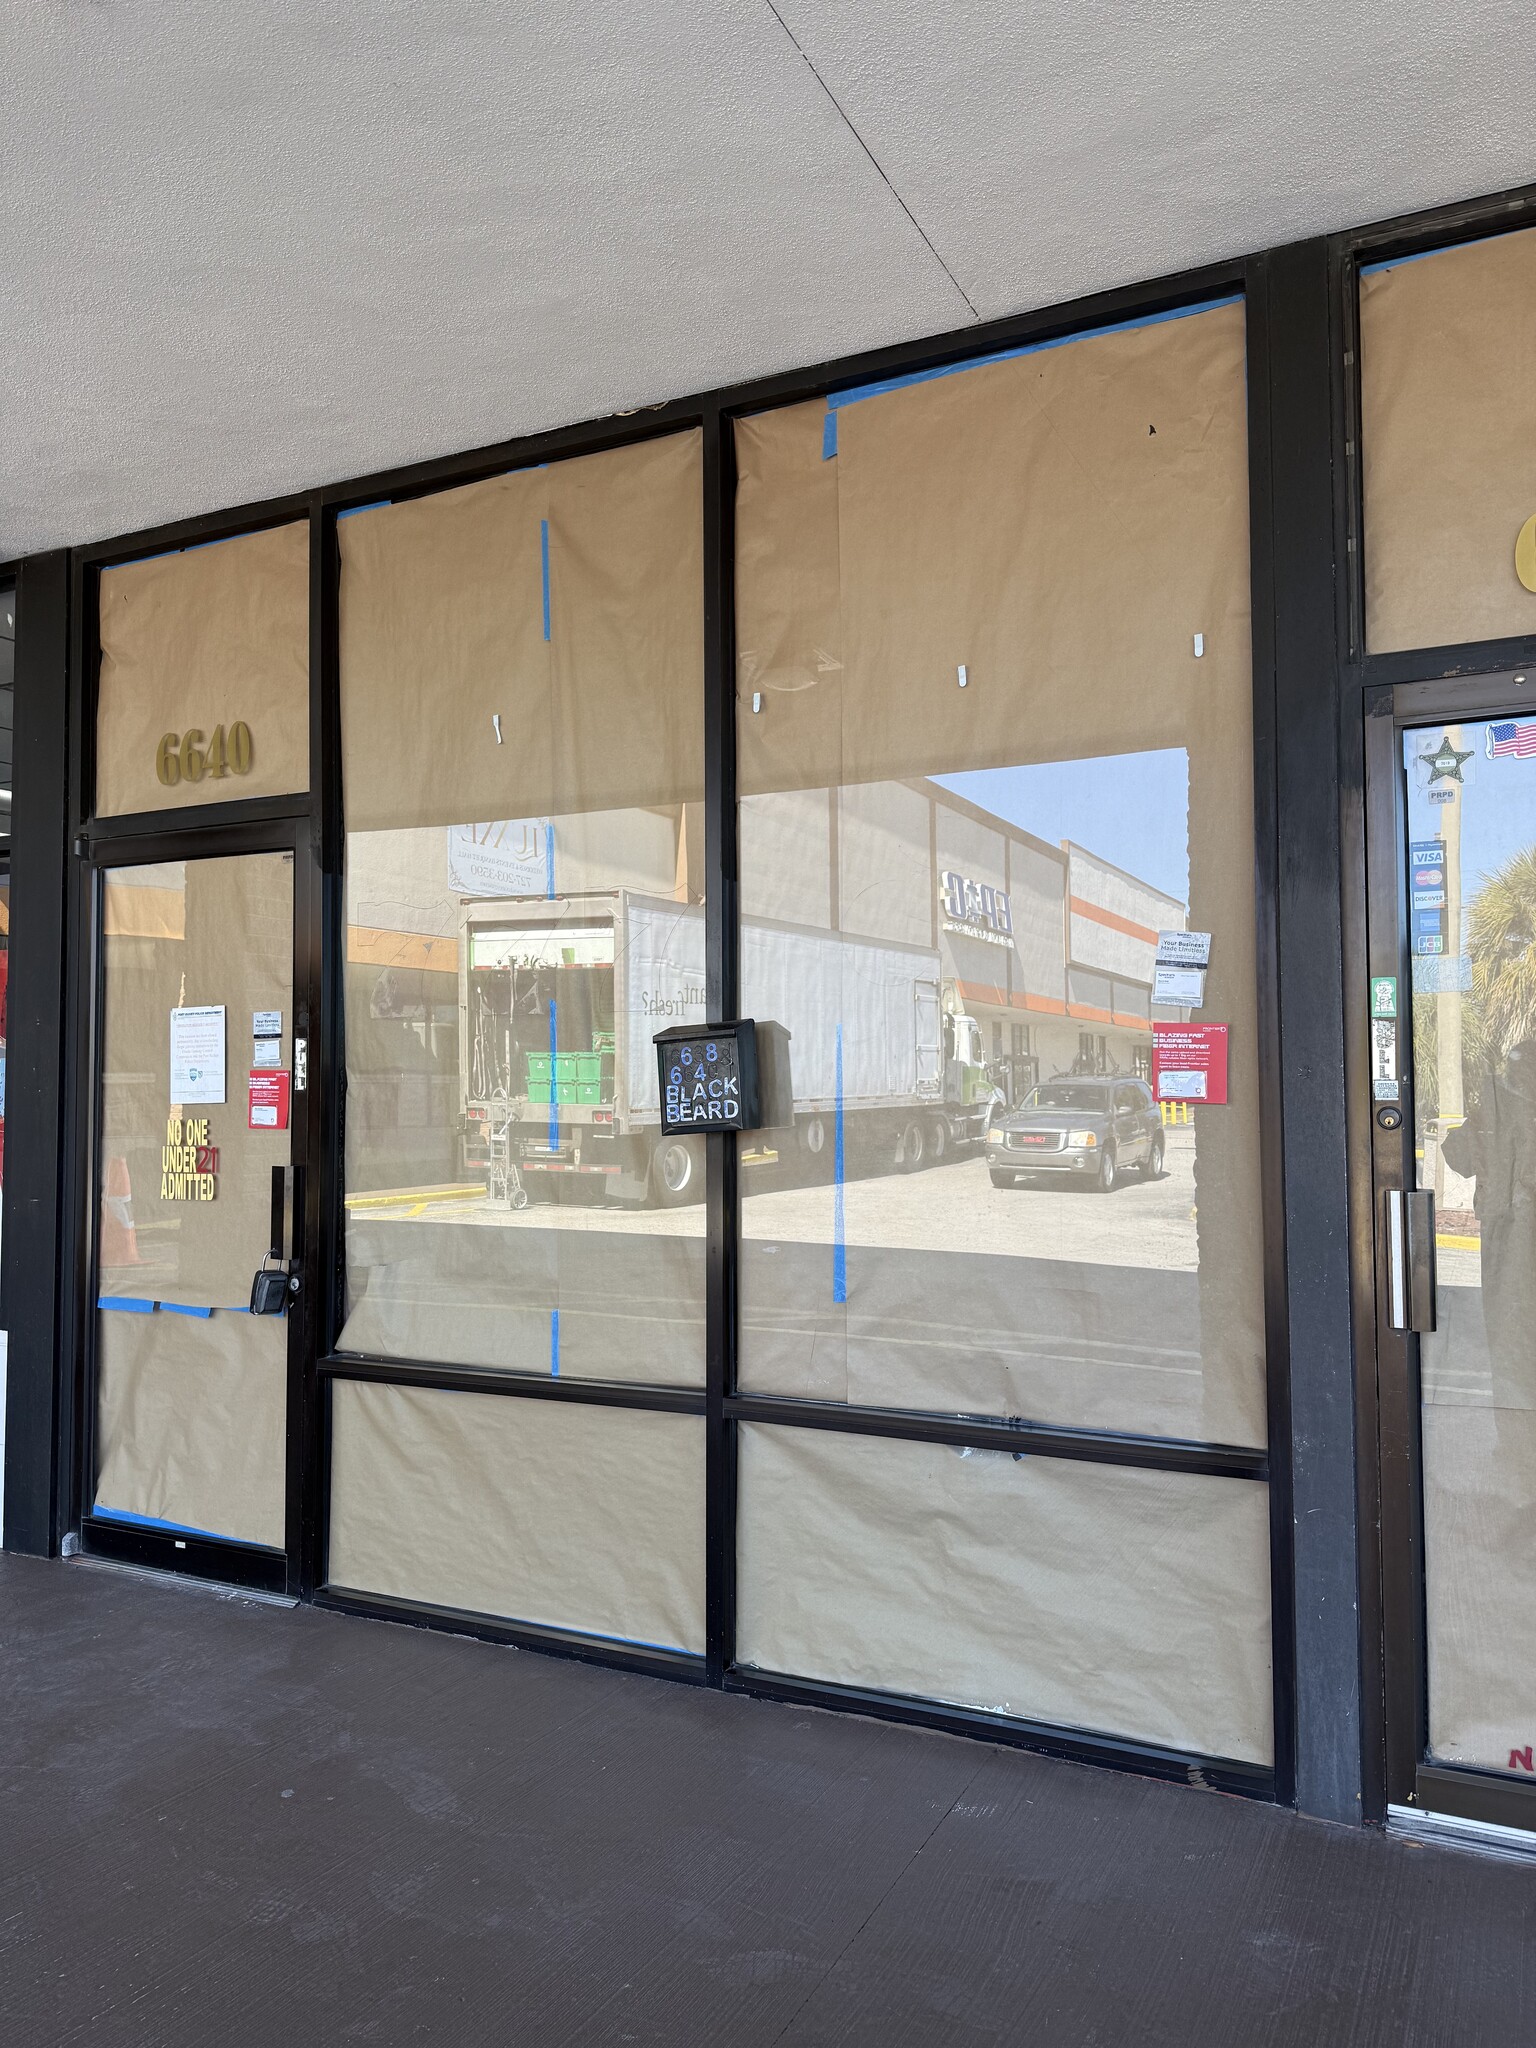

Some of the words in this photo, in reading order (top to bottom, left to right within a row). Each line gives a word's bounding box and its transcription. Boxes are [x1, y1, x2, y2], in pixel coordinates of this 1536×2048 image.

[156, 720, 253, 787] 6640
[1430, 790, 1454, 800] PRPD
[1416, 853, 1443, 863] VISA
[1178, 946, 1206, 954] Limitless
[666, 1077, 739, 1104] BLACK
[666, 1099, 739, 1123] BEARD
[167, 1119, 182, 1146] NO
[186, 1118, 208, 1146] ONE
[162, 1146, 197, 1173] UNDER
[196, 1146, 217, 1174] 21
[160, 1173, 215, 1201] ADMITTED
